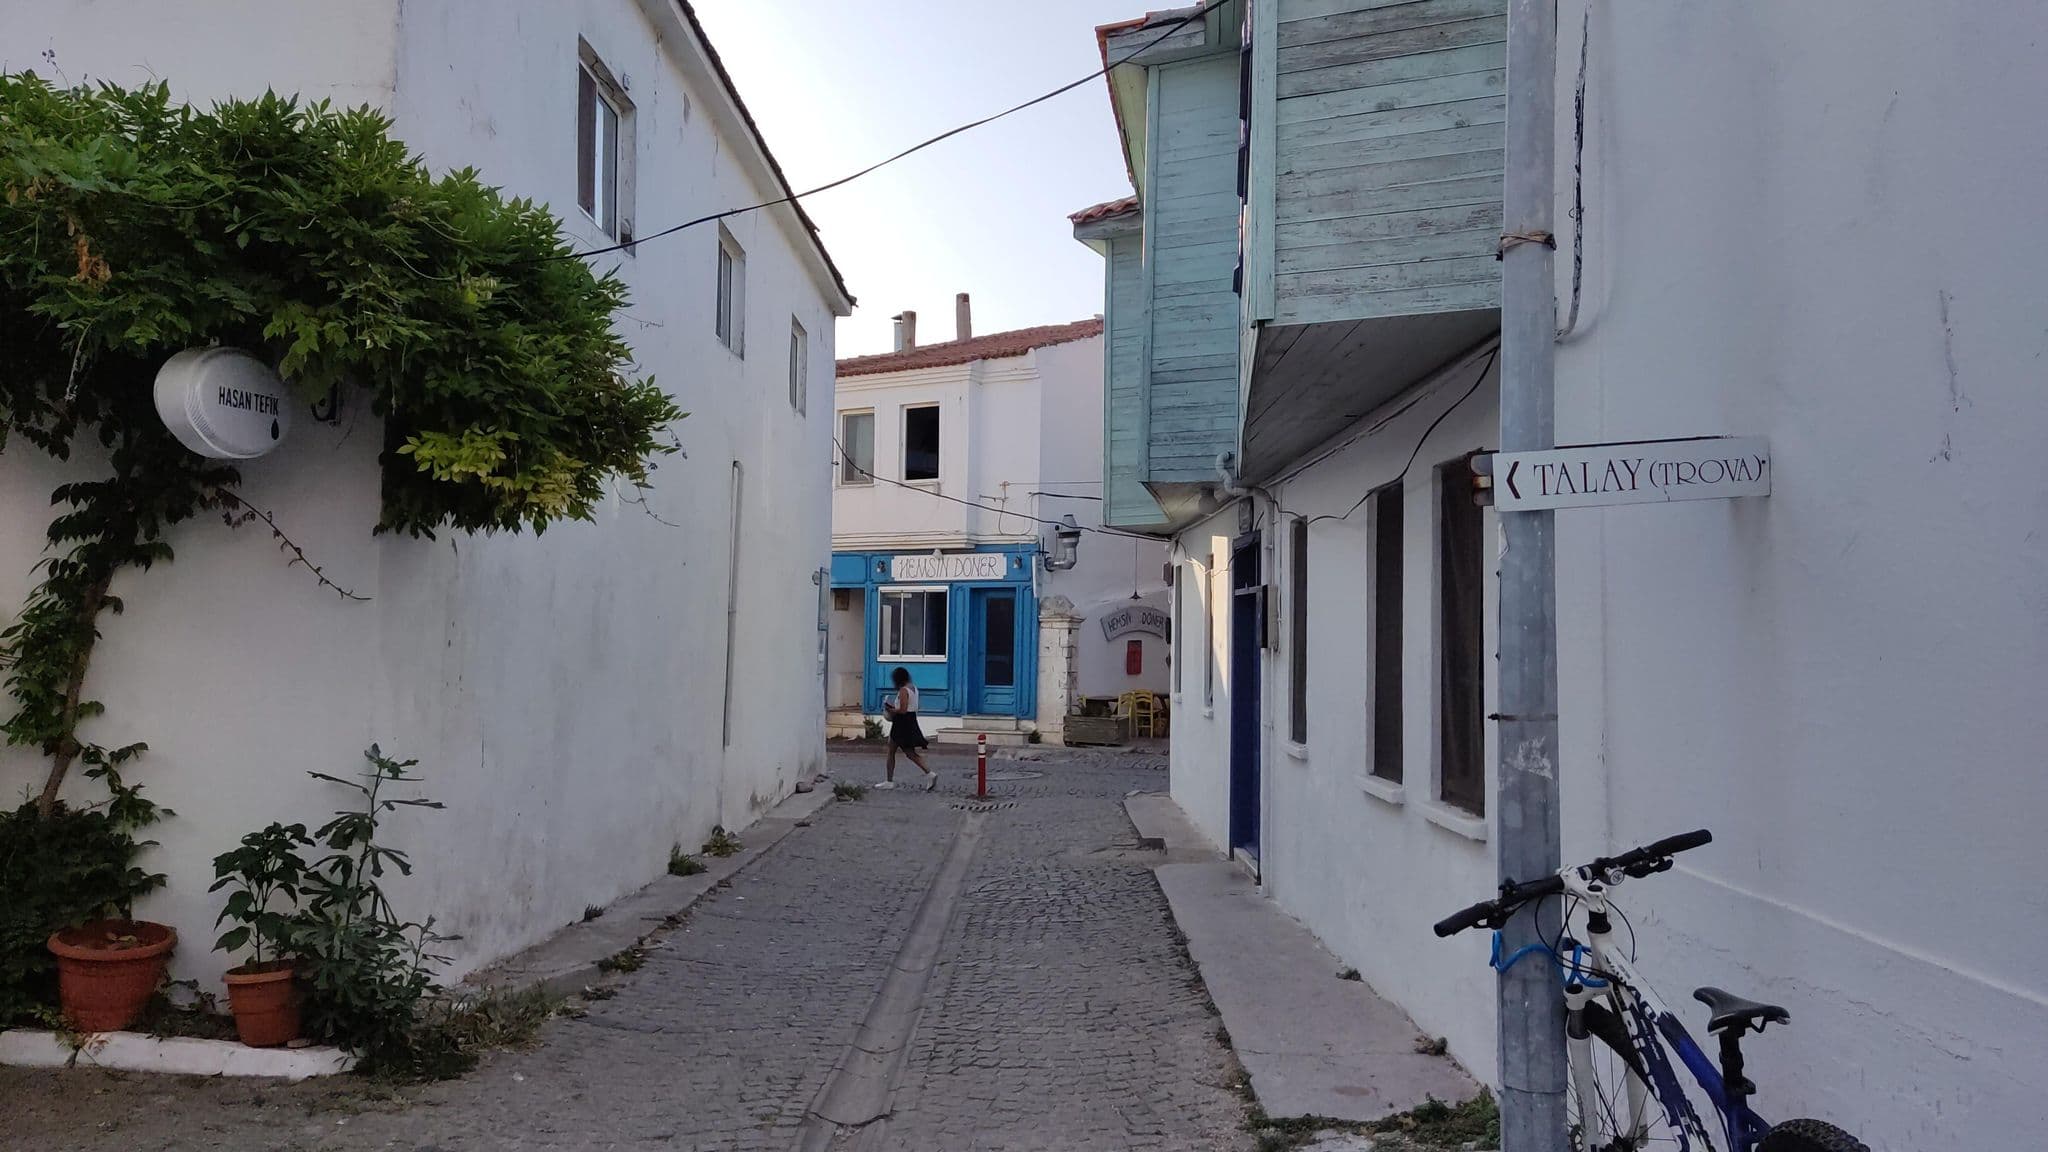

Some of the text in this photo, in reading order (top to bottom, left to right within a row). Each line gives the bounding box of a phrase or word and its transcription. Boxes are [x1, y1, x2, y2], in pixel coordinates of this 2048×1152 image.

[219, 386, 252, 411] HASAN
[1533, 454, 1762, 496] TALAY (TROVA)
